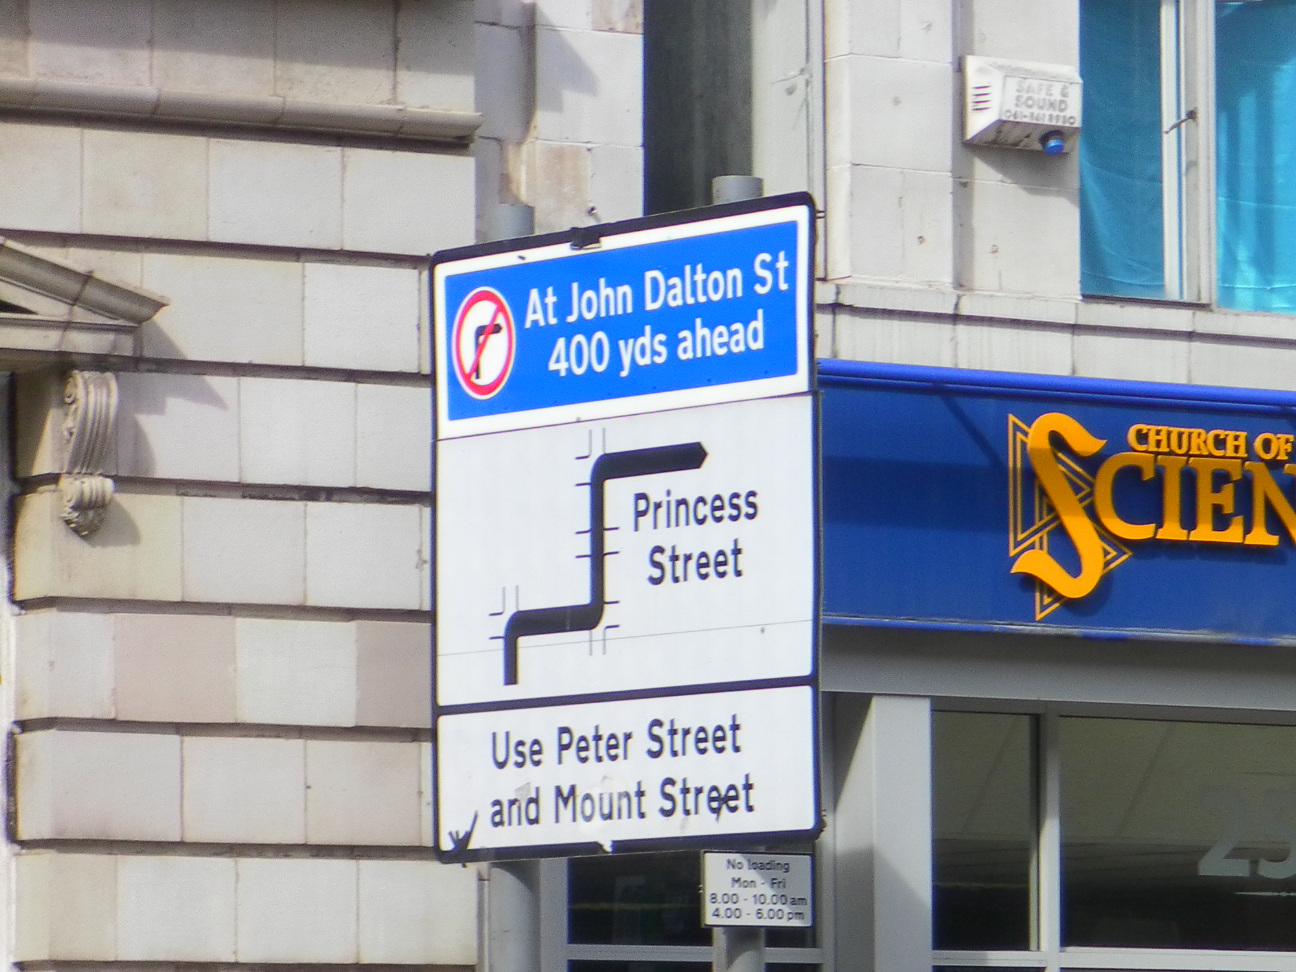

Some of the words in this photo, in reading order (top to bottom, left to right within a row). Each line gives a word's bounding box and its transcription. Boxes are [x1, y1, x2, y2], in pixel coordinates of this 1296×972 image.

[1014, 95, 1068, 113] SOUND
[1016, 80, 1053, 97] SAFE
[524, 286, 557, 329] At
[566, 278, 633, 323] John
[643, 262, 742, 311] Dalton
[753, 250, 790, 295] St
[548, 330, 610, 377] 400
[618, 324, 668, 377] yds
[676, 308, 764, 361] ahead
[1127, 423, 1248, 459] CHURCH
[1253, 432, 1294, 461] OF
[633, 488, 759, 532] Princess
[647, 537, 743, 586] Street
[491, 731, 543, 770] Use
[557, 724, 633, 765] Peter
[646, 713, 742, 759] Street
[490, 786, 540, 828] and
[554, 780, 646, 824] Mount
[659, 773, 755, 818] Street
[726, 858, 744, 870] No
[747, 858, 790, 873] loading
[731, 877, 757, 889] Mon
[770, 877, 786, 889] Fri
[709, 892, 739, 904] 8.00
[752, 893, 788, 905] 10.00
[790, 896, 807, 906] am
[711, 907, 742, 919] 4.00
[756, 908, 784, 920] 6.00
[787, 911, 805, 922] pm
